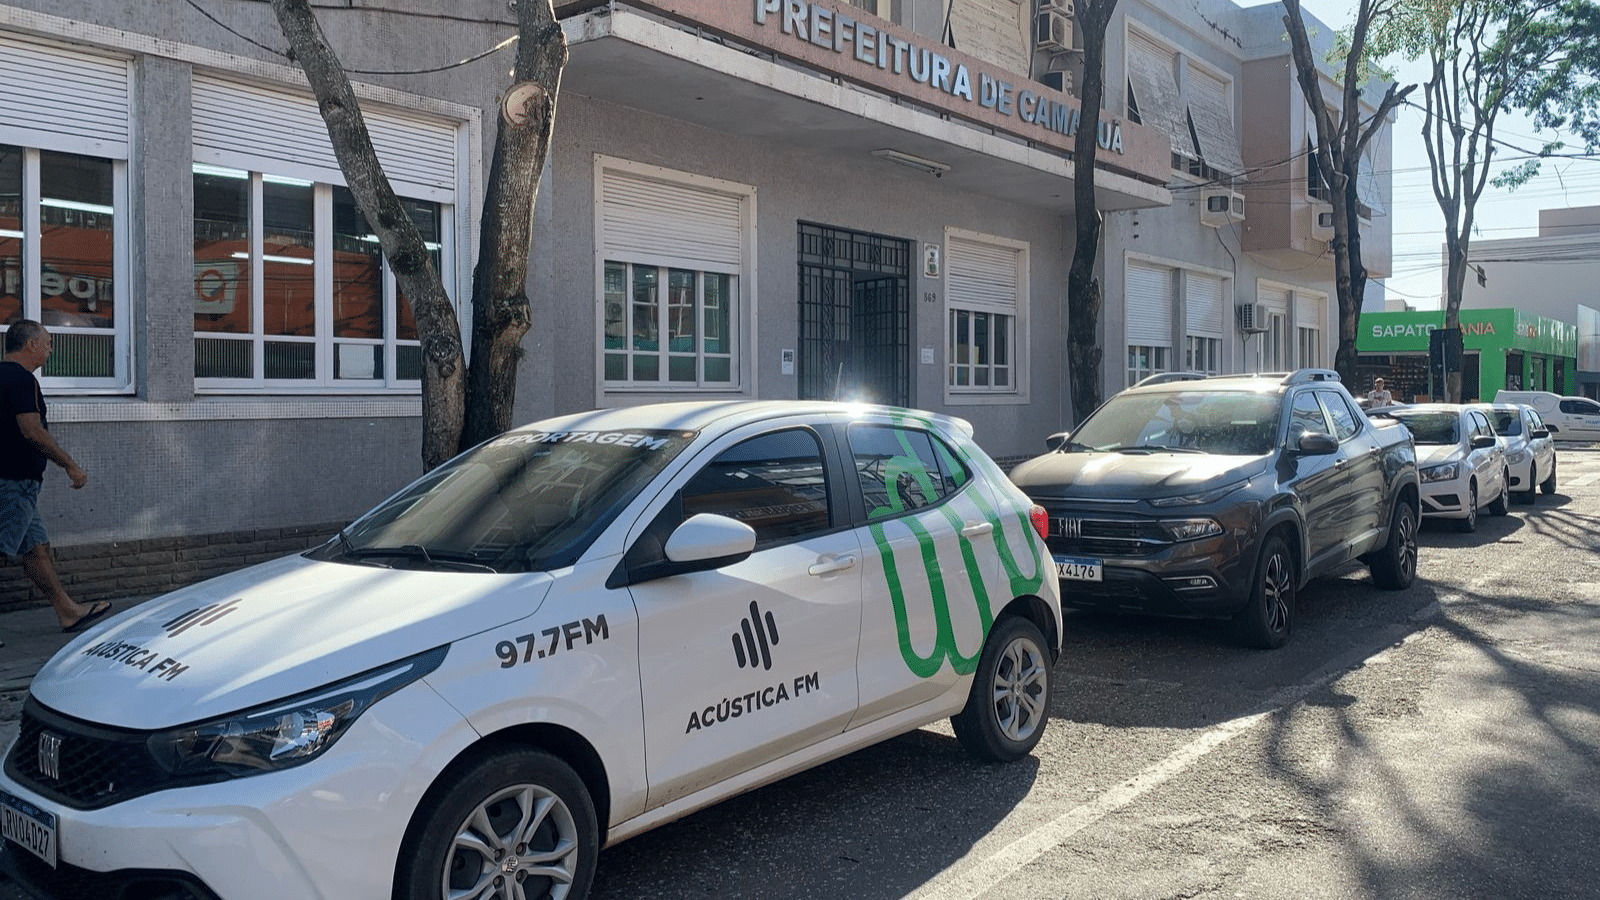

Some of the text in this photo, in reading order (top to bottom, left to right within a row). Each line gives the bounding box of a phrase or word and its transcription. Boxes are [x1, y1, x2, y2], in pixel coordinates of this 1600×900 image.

[754, 0, 1124, 154] PREFEITURA DE CAMAUÃ
[924, 292, 937, 303] 869
[1058, 517, 1083, 538] FIAT
[1055, 563, 1095, 579] X4I76
[82, 640, 190, 682] ACÚSTICA FM
[495, 613, 610, 669] 97.7FM
[685, 671, 820, 734] ACÚSTICA FM
